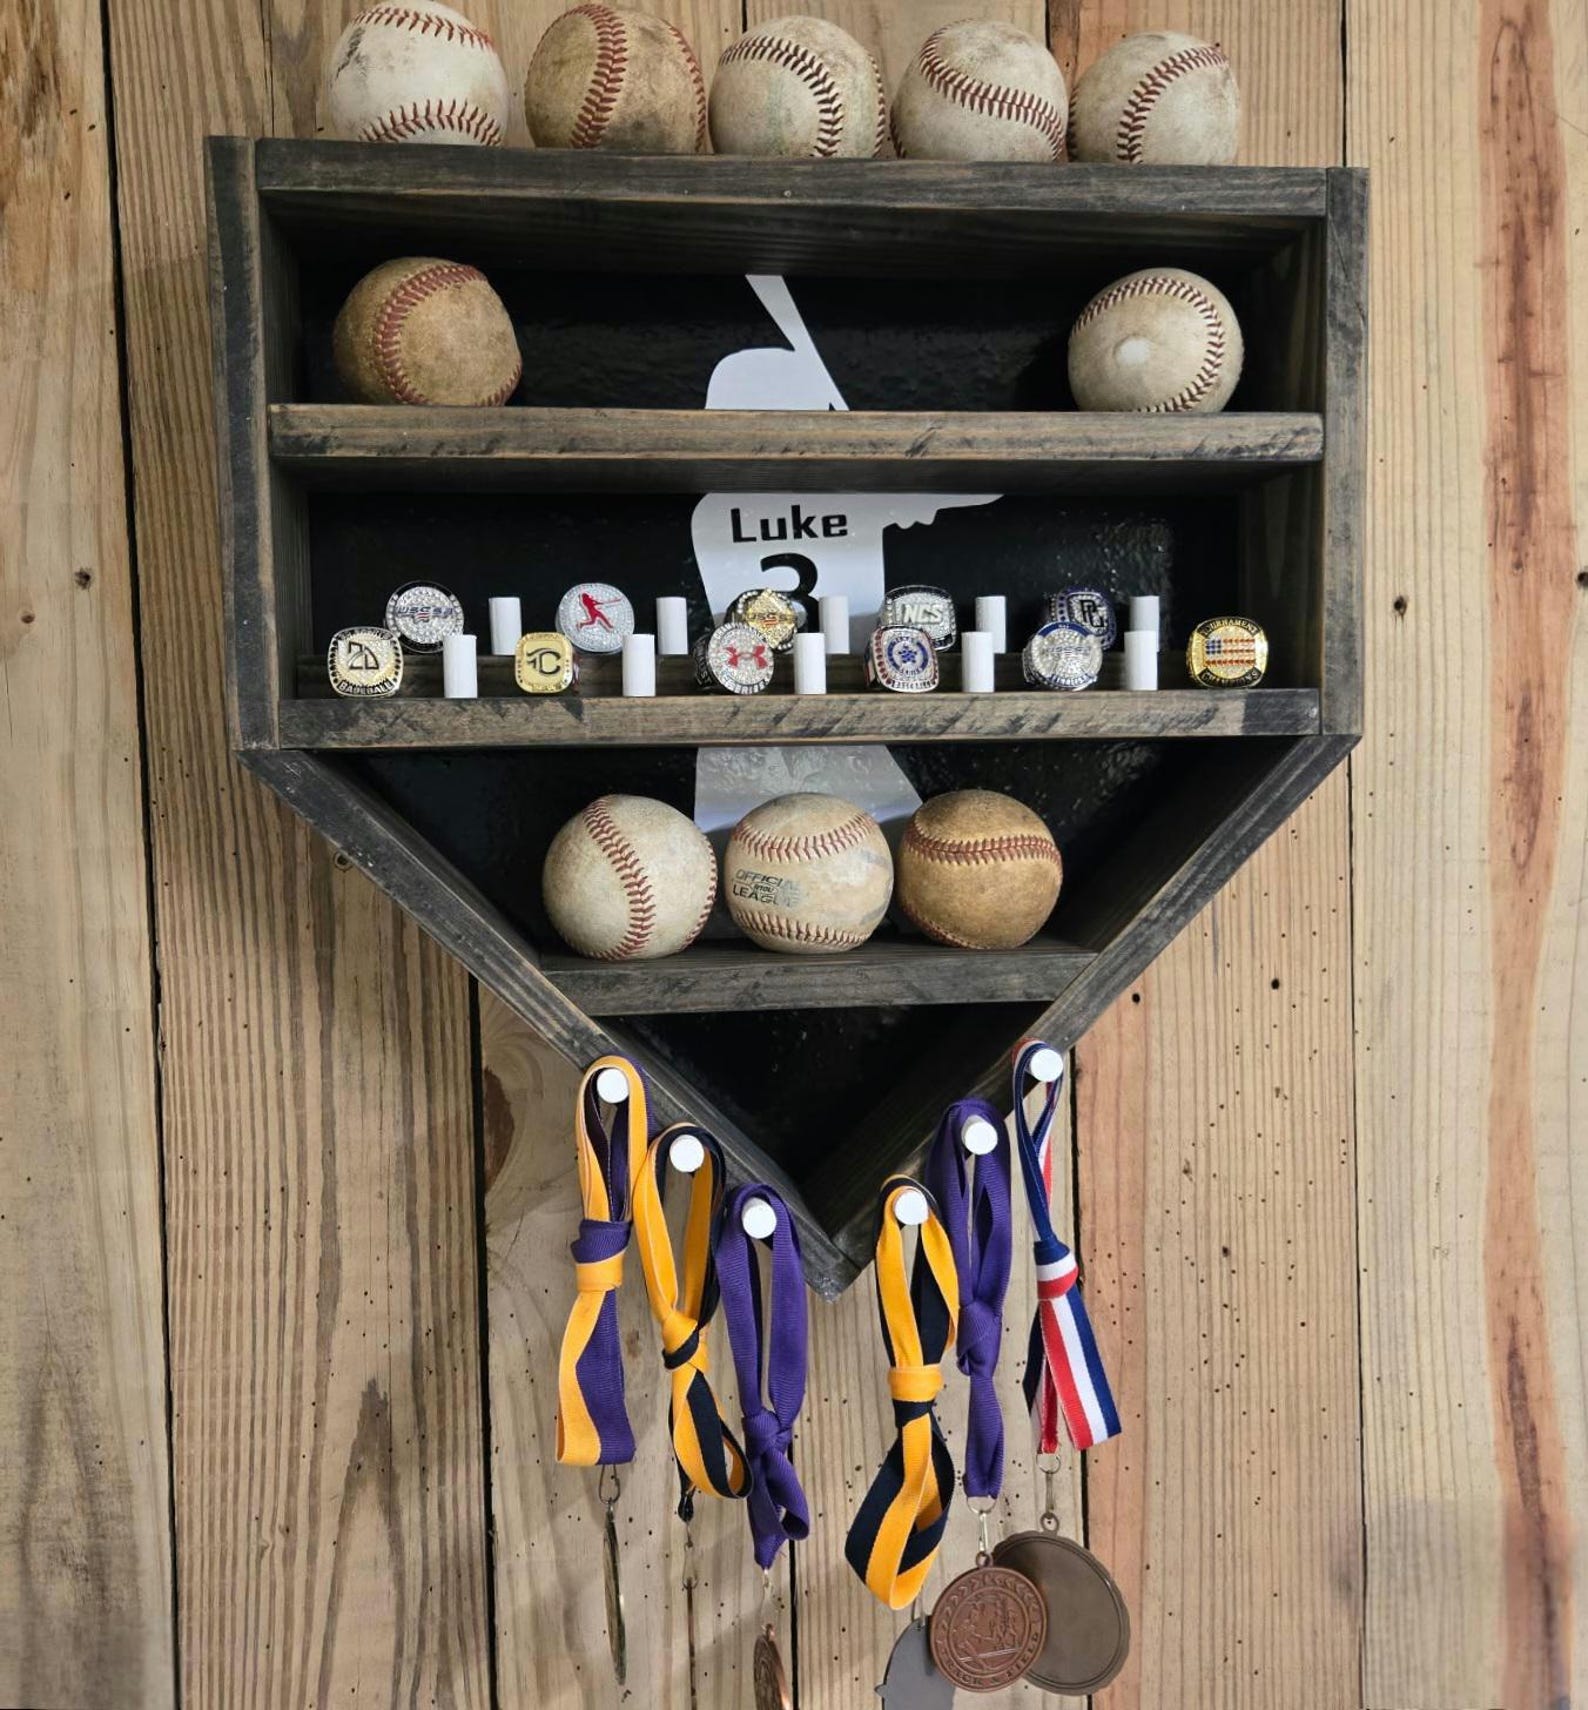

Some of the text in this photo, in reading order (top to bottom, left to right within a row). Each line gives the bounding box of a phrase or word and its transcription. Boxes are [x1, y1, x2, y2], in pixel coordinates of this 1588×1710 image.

[730, 504, 849, 543] Luke
[760, 552, 821, 634] 3
[338, 677, 396, 696] BASEBALL
